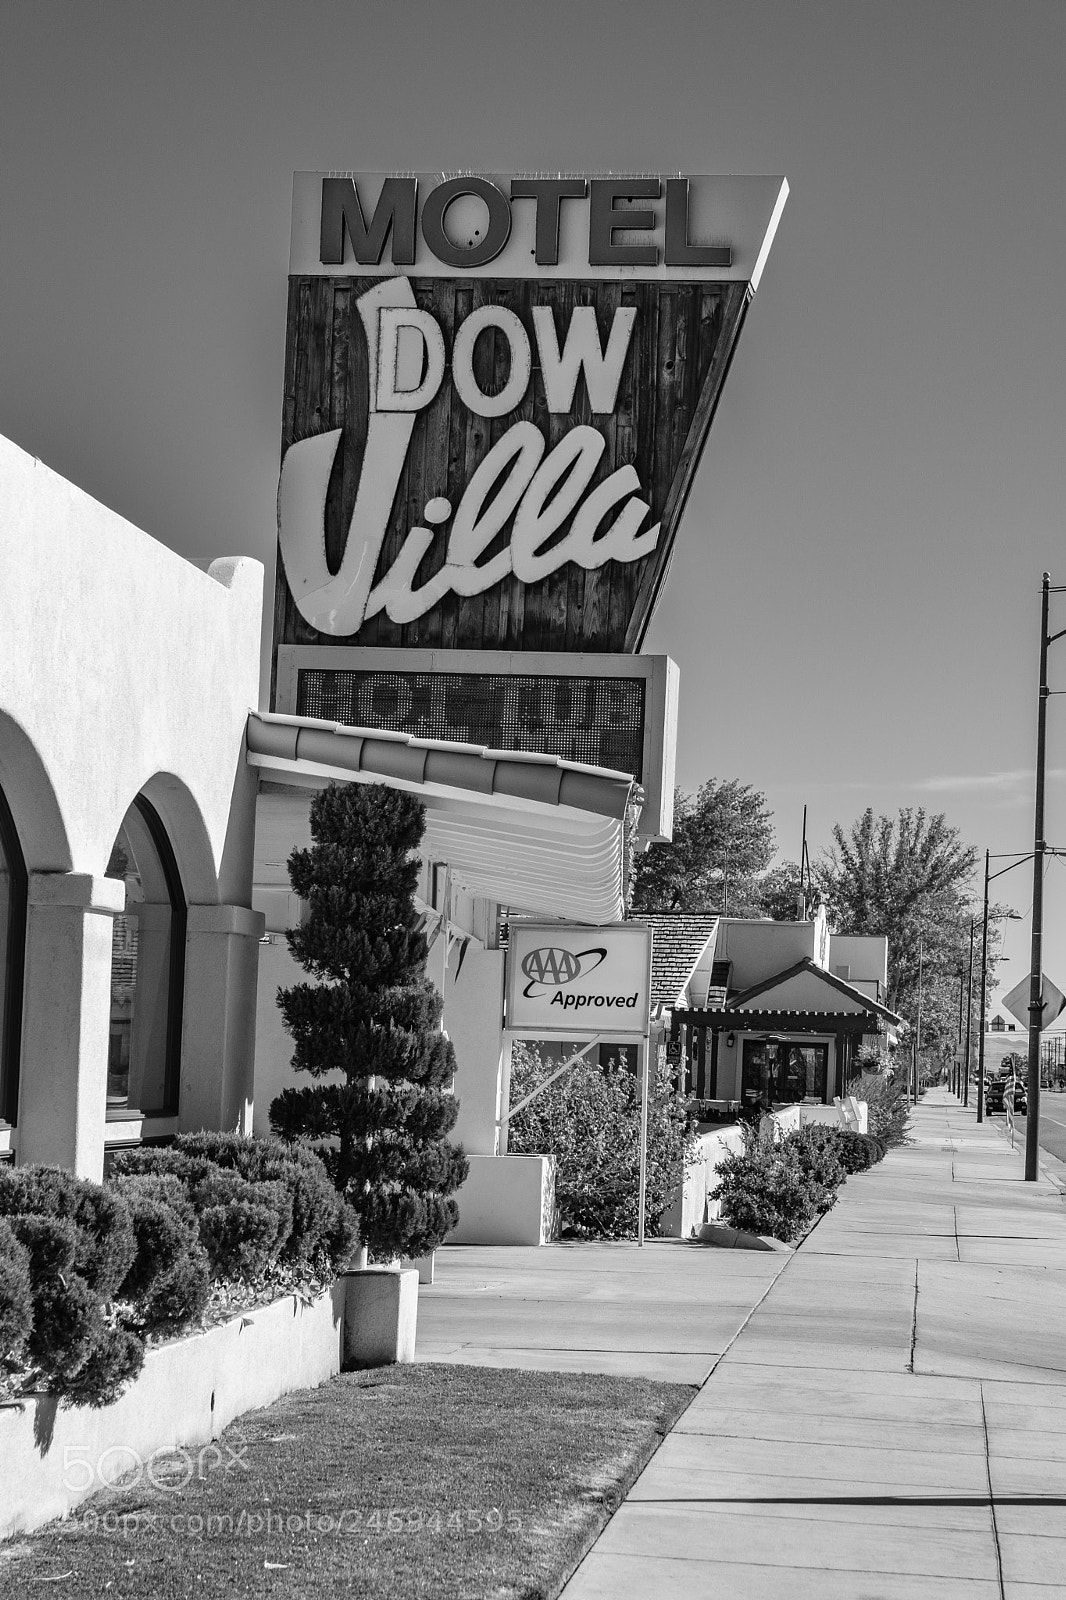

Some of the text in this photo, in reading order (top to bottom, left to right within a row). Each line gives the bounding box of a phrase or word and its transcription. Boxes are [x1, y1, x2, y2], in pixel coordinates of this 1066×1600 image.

[319, 176, 732, 268] MOTEL
[376, 305, 638, 418] DOW
[277, 276, 662, 637] Villa
[525, 948, 577, 984] AAA
[550, 990, 639, 1010] Approved
